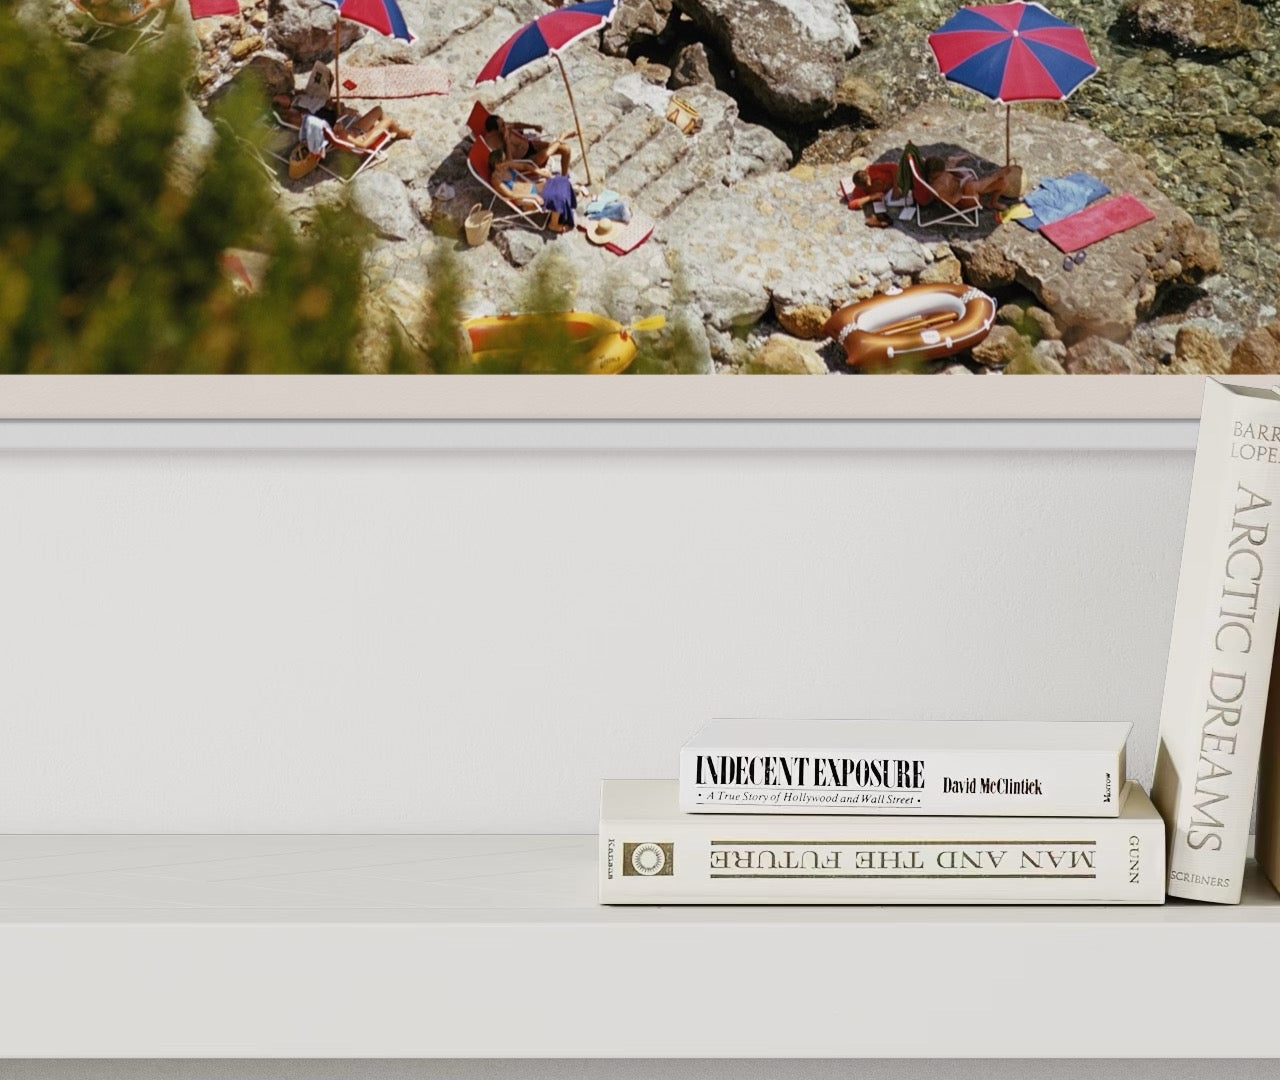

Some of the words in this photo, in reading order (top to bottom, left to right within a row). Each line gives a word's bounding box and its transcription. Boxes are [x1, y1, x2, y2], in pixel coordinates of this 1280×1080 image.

[1215, 481, 1272, 654] ARCTIC
[1187, 668, 1247, 852] DREAMS
[695, 755, 809, 786] INDECENT
[814, 758, 925, 788] EXPOSURE
[943, 777, 977, 794] David
[980, 777, 1043, 795] McClintick
[707, 791, 715, 800] A
[718, 791, 740, 801] True
[742, 791, 768, 802] Story
[770, 791, 781, 803] of
[783, 792, 838, 804] Hollywood
[840, 793, 858, 804] and
[861, 794, 884, 805] Wall
[887, 795, 913, 805] Street
[710, 850, 843, 869] FUTURE
[856, 850, 924, 869] THE
[936, 850, 1008, 869] AND
[1020, 850, 1096, 869] MAN
[1129, 835, 1140, 884] GUNN
[1170, 870, 1231, 888] SCRIBNERS
